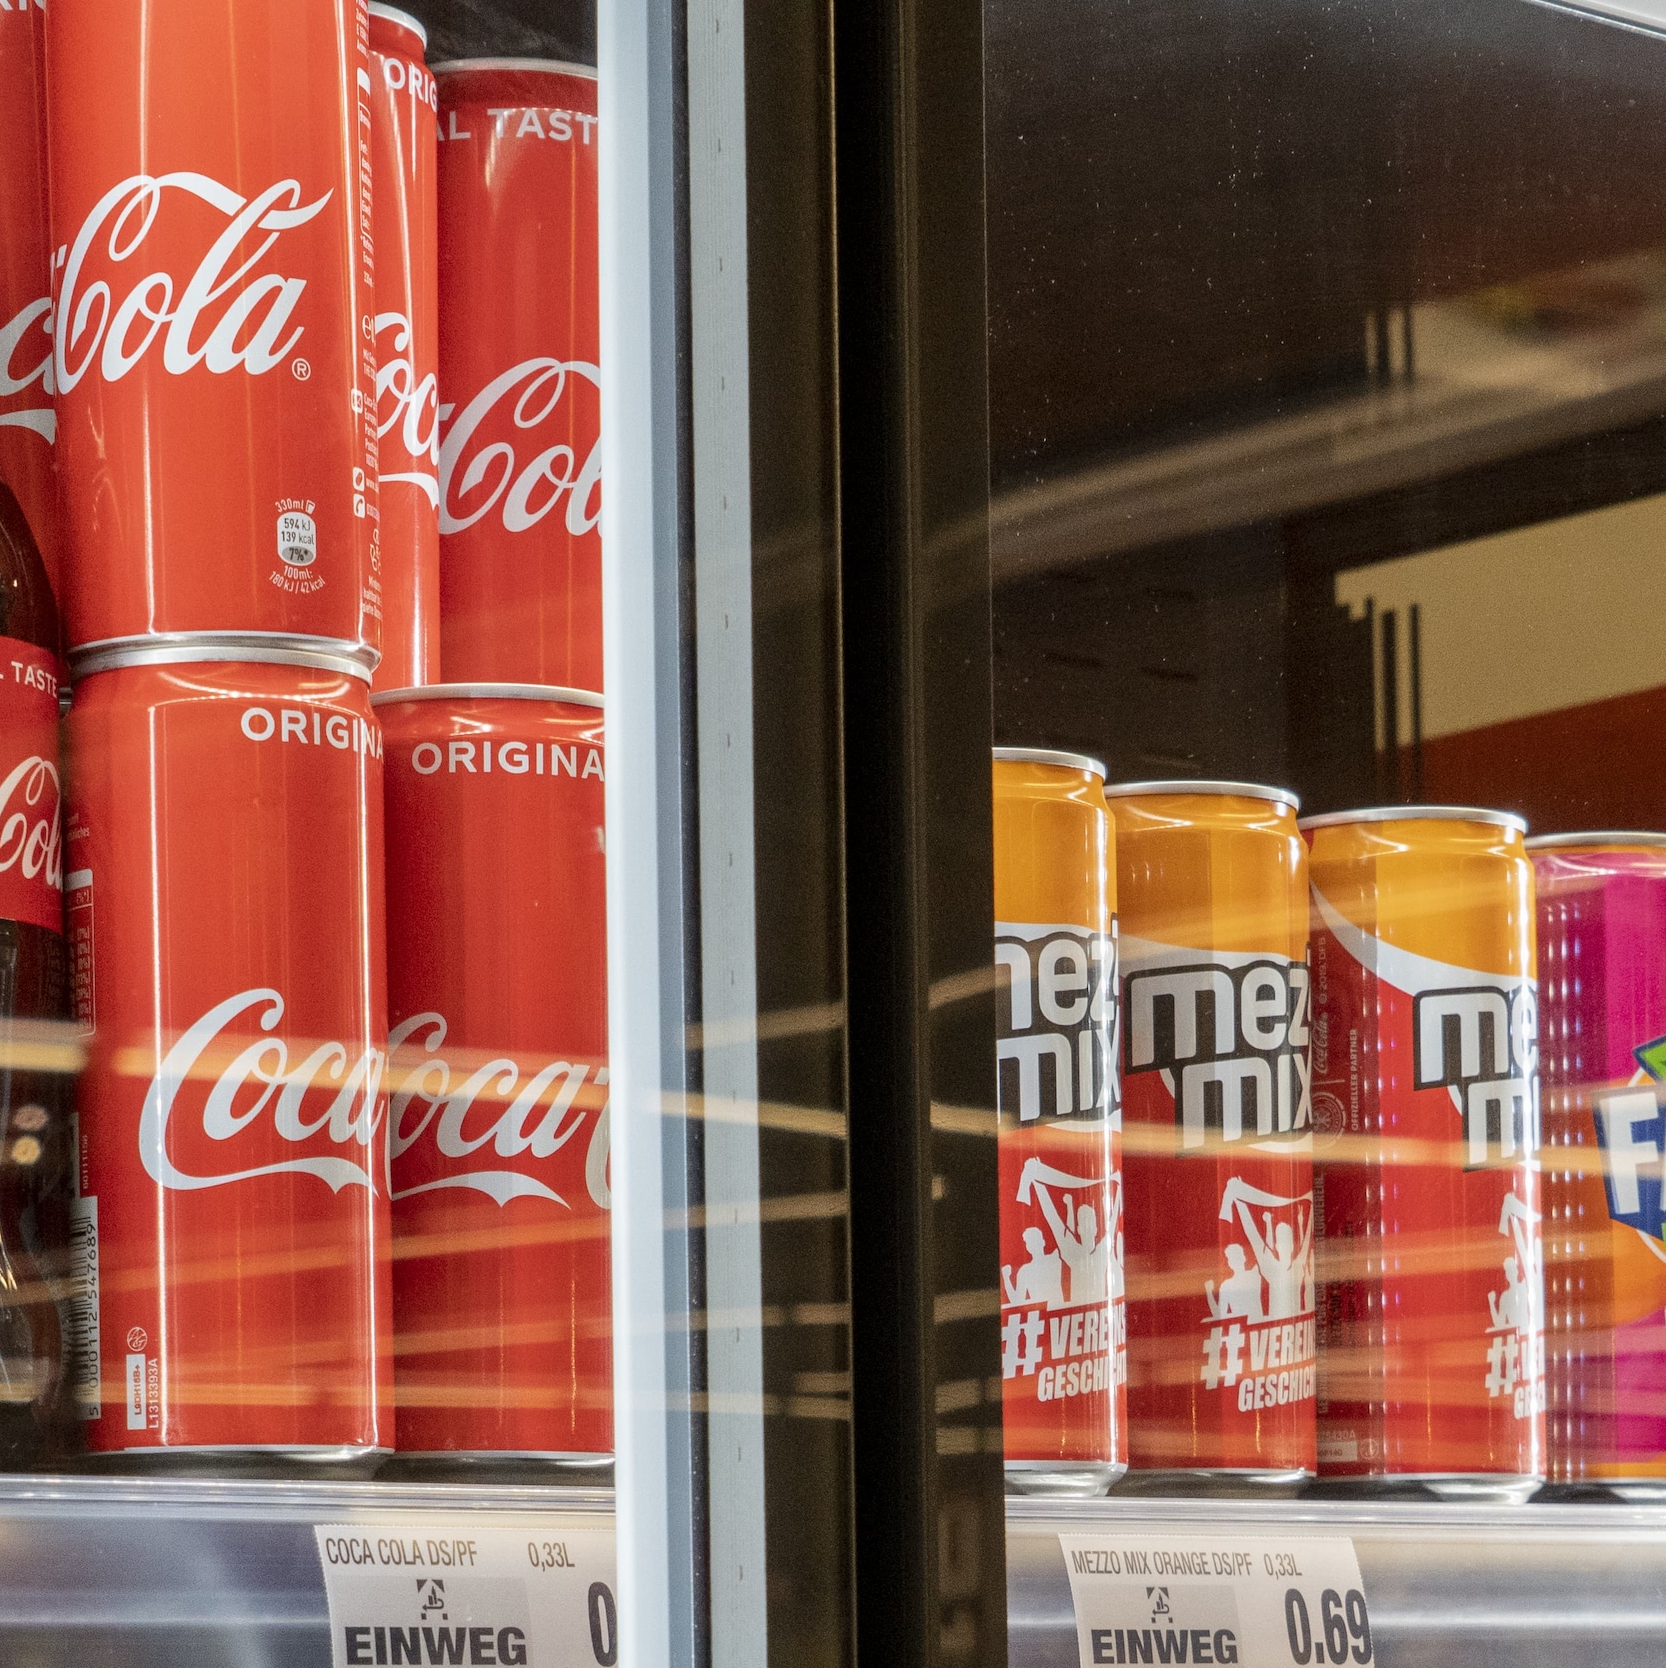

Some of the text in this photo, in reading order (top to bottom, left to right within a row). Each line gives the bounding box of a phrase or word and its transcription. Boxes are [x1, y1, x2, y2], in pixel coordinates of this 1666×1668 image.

[384, 57, 438, 113] ORIG
[487, 107, 598, 143] TAST
[55, 171, 333, 396] Cola
[275, 498, 304, 512] 330ml
[284, 518, 311, 531] 594 kJ
[281, 531, 314, 545] 139 kcal
[269, 571, 325, 594] 180 kJ 42 kcal
[284, 565, 313, 580] 100ml:
[240, 707, 383, 759] ORIGINA
[411, 740, 605, 782] ORIGINA
[995, 918, 1119, 1031] mez
[1131, 948, 1310, 1068] mez
[1349, 1029, 1358, 1074] PARTNER
[138, 988, 383, 1196] Coca
[86, 1225, 99, 1388] 547689 000112
[1002, 1307, 1126, 1379] #VEREINS
[1200, 1318, 1317, 1390] #VEREIN
[1238, 1371, 1317, 1413] GESCHIC
[326, 1538, 575, 1572] COCA COLA DS/PF 0,33L
[1071, 1550, 1302, 1580] MEZZO MIX ORANGE DS/PF 0,33L
[345, 1626, 527, 1666] EINWEG
[587, 1581, 619, 1668] 0
[1284, 1588, 1374, 1666] 0.69
[1091, 1629, 1239, 1664] EINWEG
